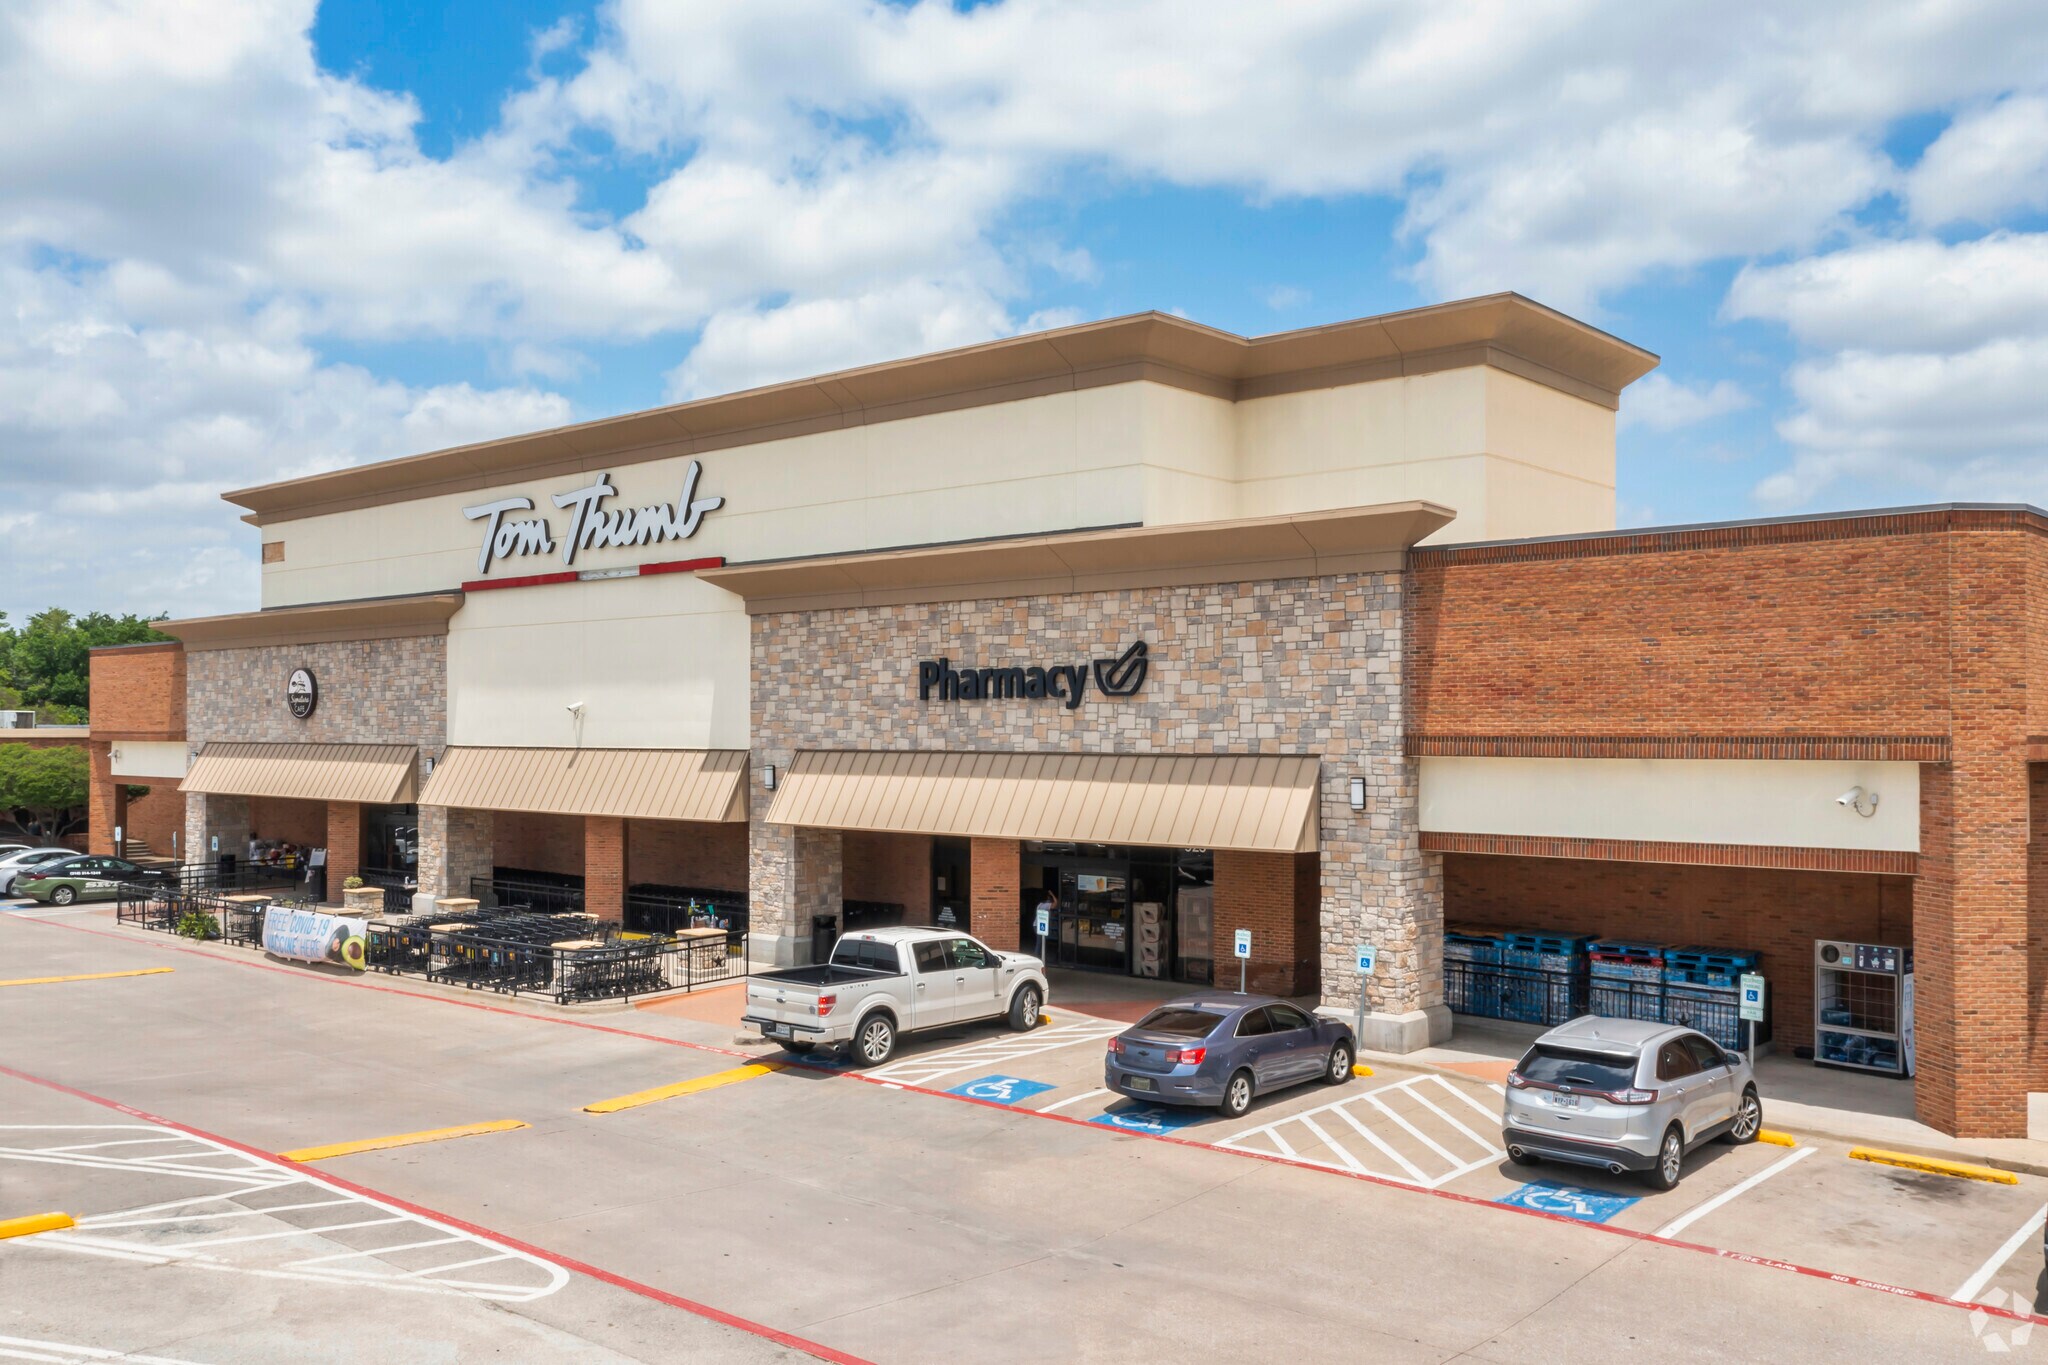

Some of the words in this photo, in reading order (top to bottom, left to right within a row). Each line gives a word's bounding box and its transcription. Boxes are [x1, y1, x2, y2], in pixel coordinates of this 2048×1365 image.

[462, 497, 556, 574] Tom
[551, 460, 726, 565] Thumb
[919, 657, 1088, 709] Pharmacy
[268, 912, 289, 931] FREE
[290, 914, 330, 936] COVID-19
[267, 934, 297, 955] VACCINE
[300, 938, 321, 959] HERE
[1830, 1274, 1850, 1282] NO
[1855, 1280, 1917, 1297] PARKING
